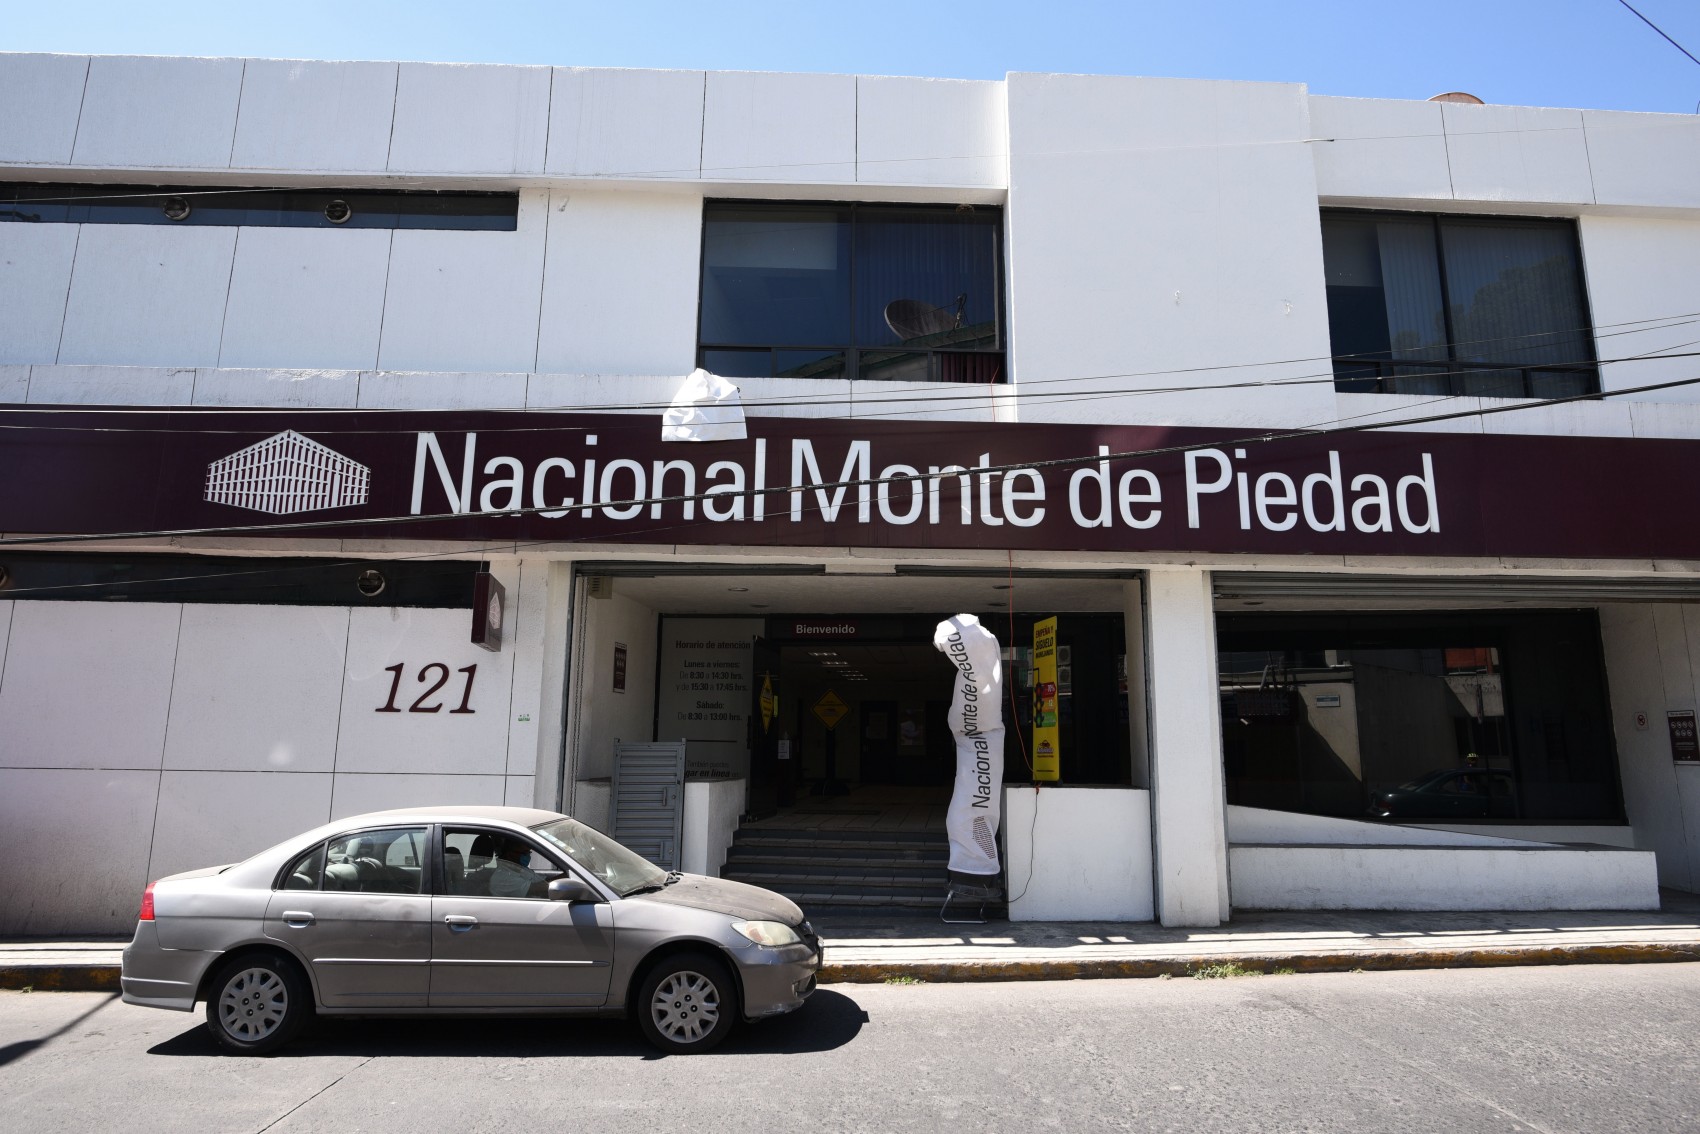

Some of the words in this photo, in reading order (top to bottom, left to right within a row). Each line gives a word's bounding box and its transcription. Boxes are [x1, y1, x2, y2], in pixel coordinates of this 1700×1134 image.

[411, 432, 766, 522] Nacional
[790, 438, 1046, 527] Monte
[1069, 445, 1162, 529] de
[1184, 448, 1440, 533] Piedad
[796, 624, 855, 634] Bienvenido
[675, 640, 704, 649] Horario
[706, 640, 715, 649] de
[717, 640, 751, 649] atención
[684, 660, 705, 668] Lunes
[689, 672, 705, 680] 8:30
[711, 672, 729, 680] 14:30
[375, 662, 478, 713] 121
[691, 683, 709, 691] 15:30
[961, 683, 978, 702] de
[696, 700, 725, 709] Sábado:
[687, 712, 703, 720] 8:30
[710, 712, 728, 720] 13:00
